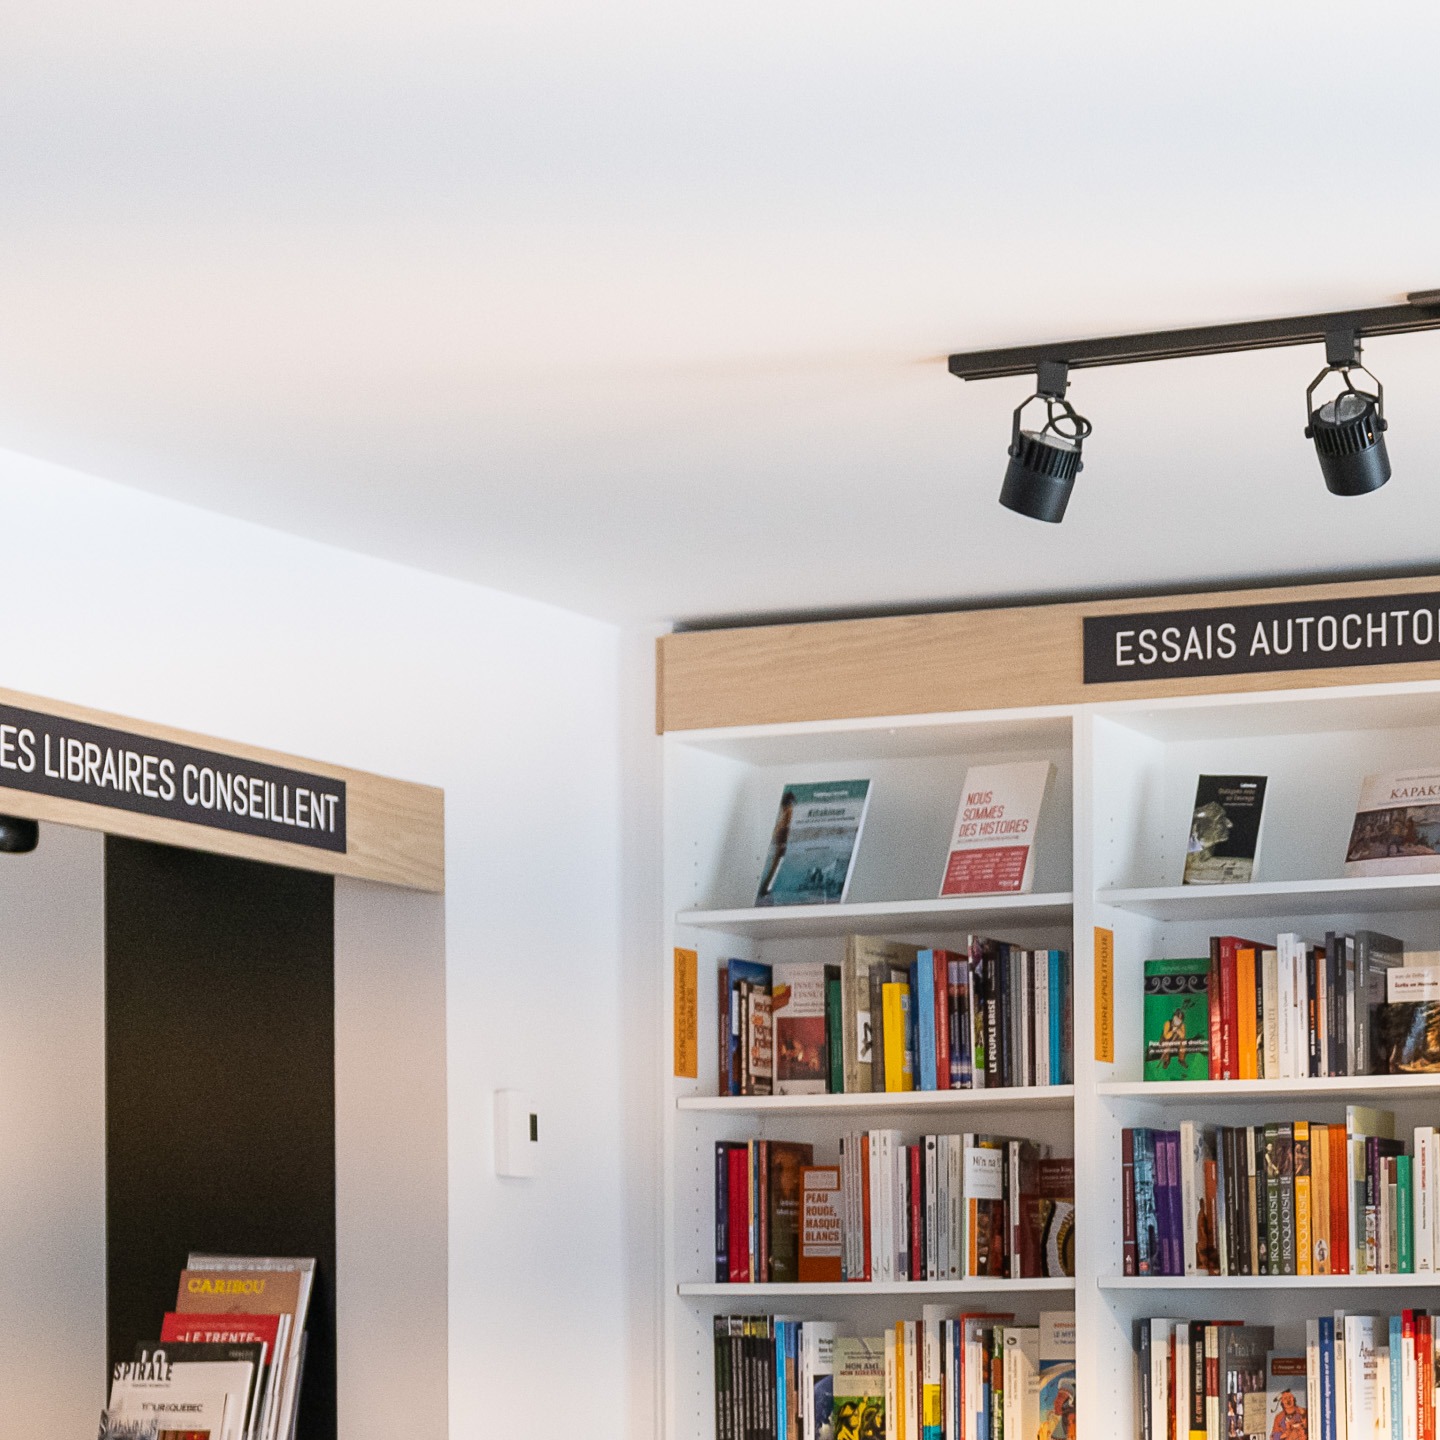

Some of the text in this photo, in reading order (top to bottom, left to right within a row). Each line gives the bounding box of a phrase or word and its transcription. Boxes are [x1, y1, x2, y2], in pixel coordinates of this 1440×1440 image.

[1115, 622, 1236, 666] ESSAIS
[44, 733, 176, 801] LIBRAIRES
[183, 764, 339, 833] CONSEILLENT
[967, 791, 992, 805] NOUS
[963, 806, 1004, 821] SOMMES
[959, 819, 1029, 837] DES HISTOIRES
[989, 1027, 997, 1061] PEUPLE
[989, 1062, 997, 1073] LE
[806, 1193, 828, 1203] PEAU
[806, 1205, 837, 1217] ROUGE,
[806, 1231, 839, 1242] BLANCS
[188, 1279, 265, 1294] CARIBOU
[113, 1362, 174, 1382] SPIRALE
